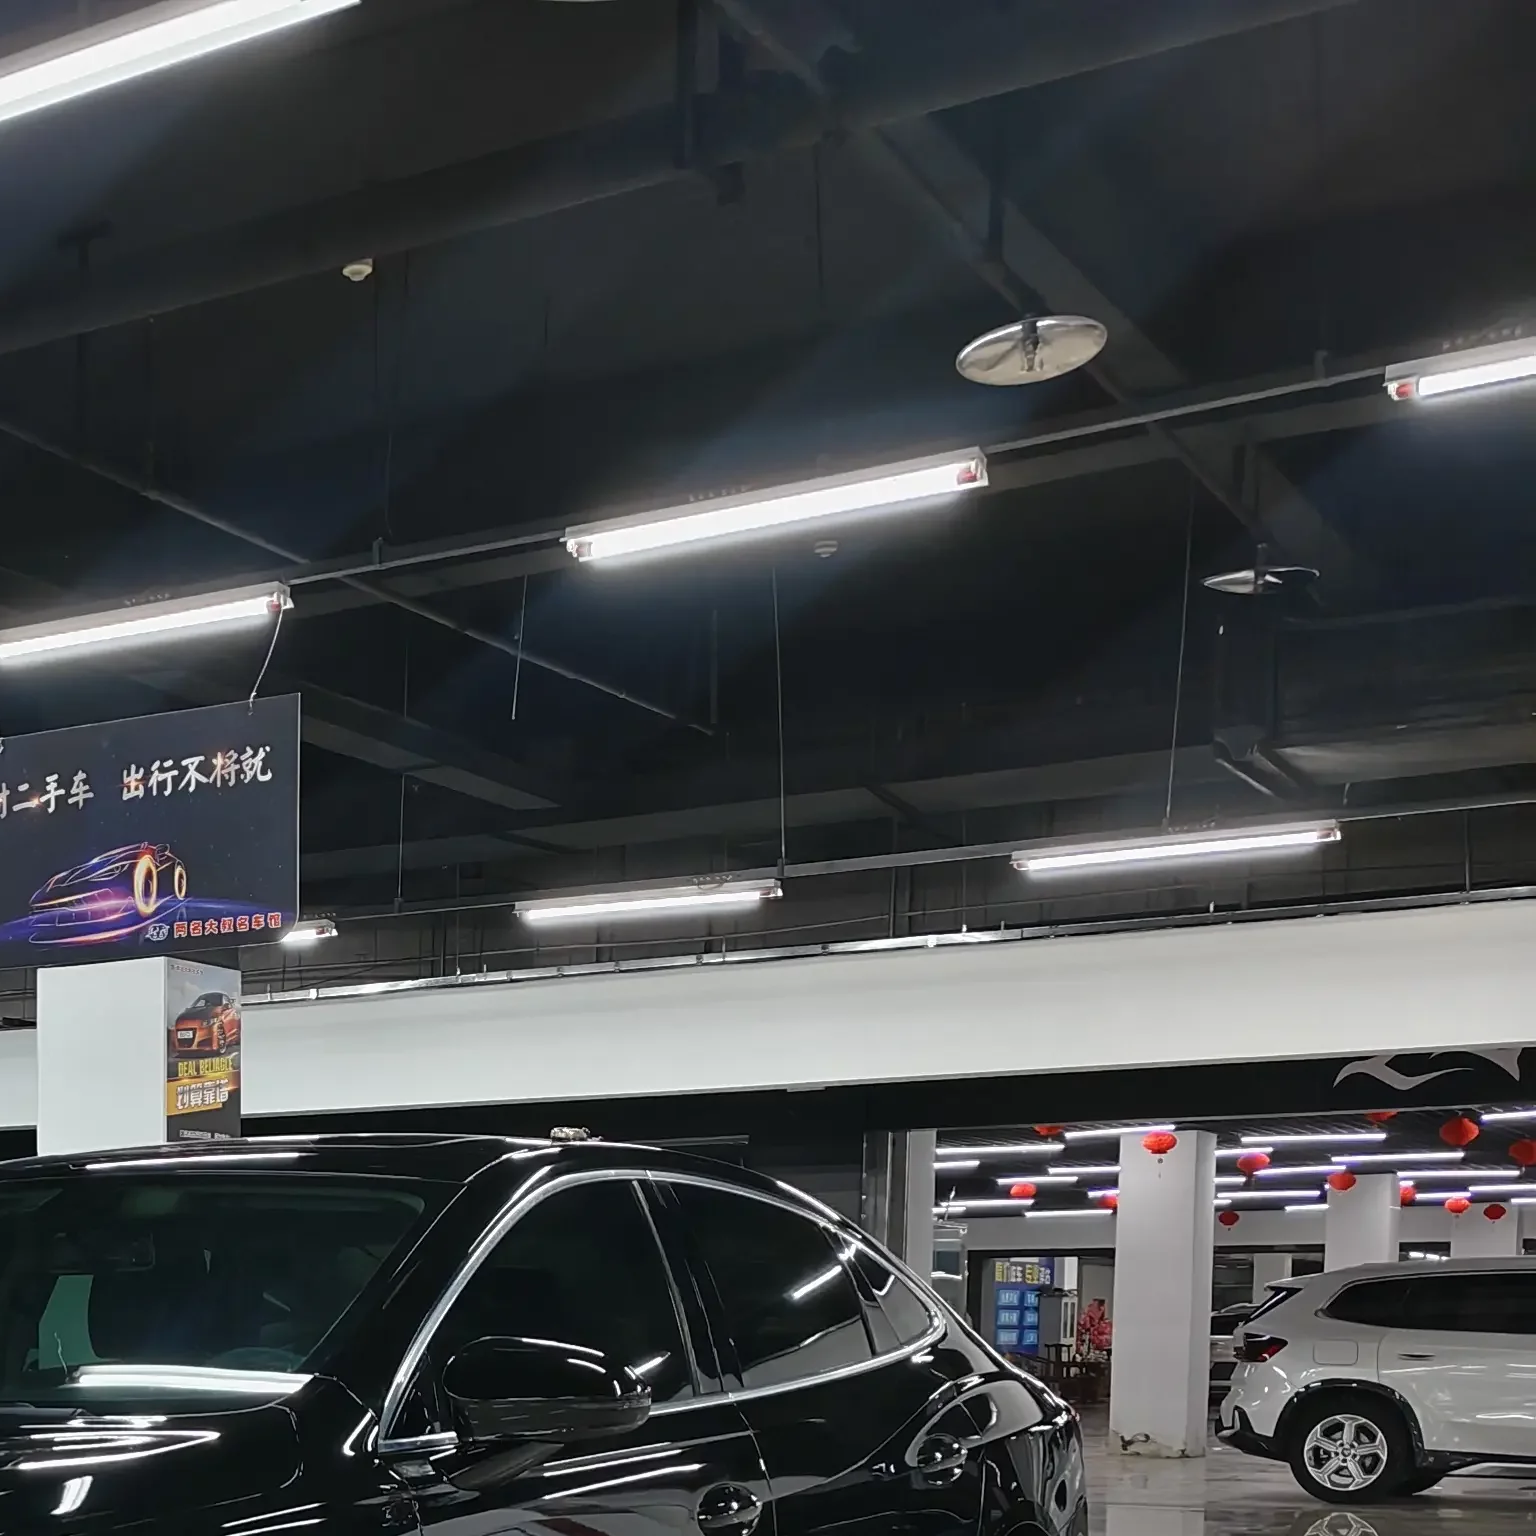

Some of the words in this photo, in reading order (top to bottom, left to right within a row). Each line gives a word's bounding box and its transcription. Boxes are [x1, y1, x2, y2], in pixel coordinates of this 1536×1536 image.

[120, 745, 273, 801] 出行不将就
[173, 912, 282, 938] 两名大叔名车馆
[178, 1060, 198, 1077] DEAL
